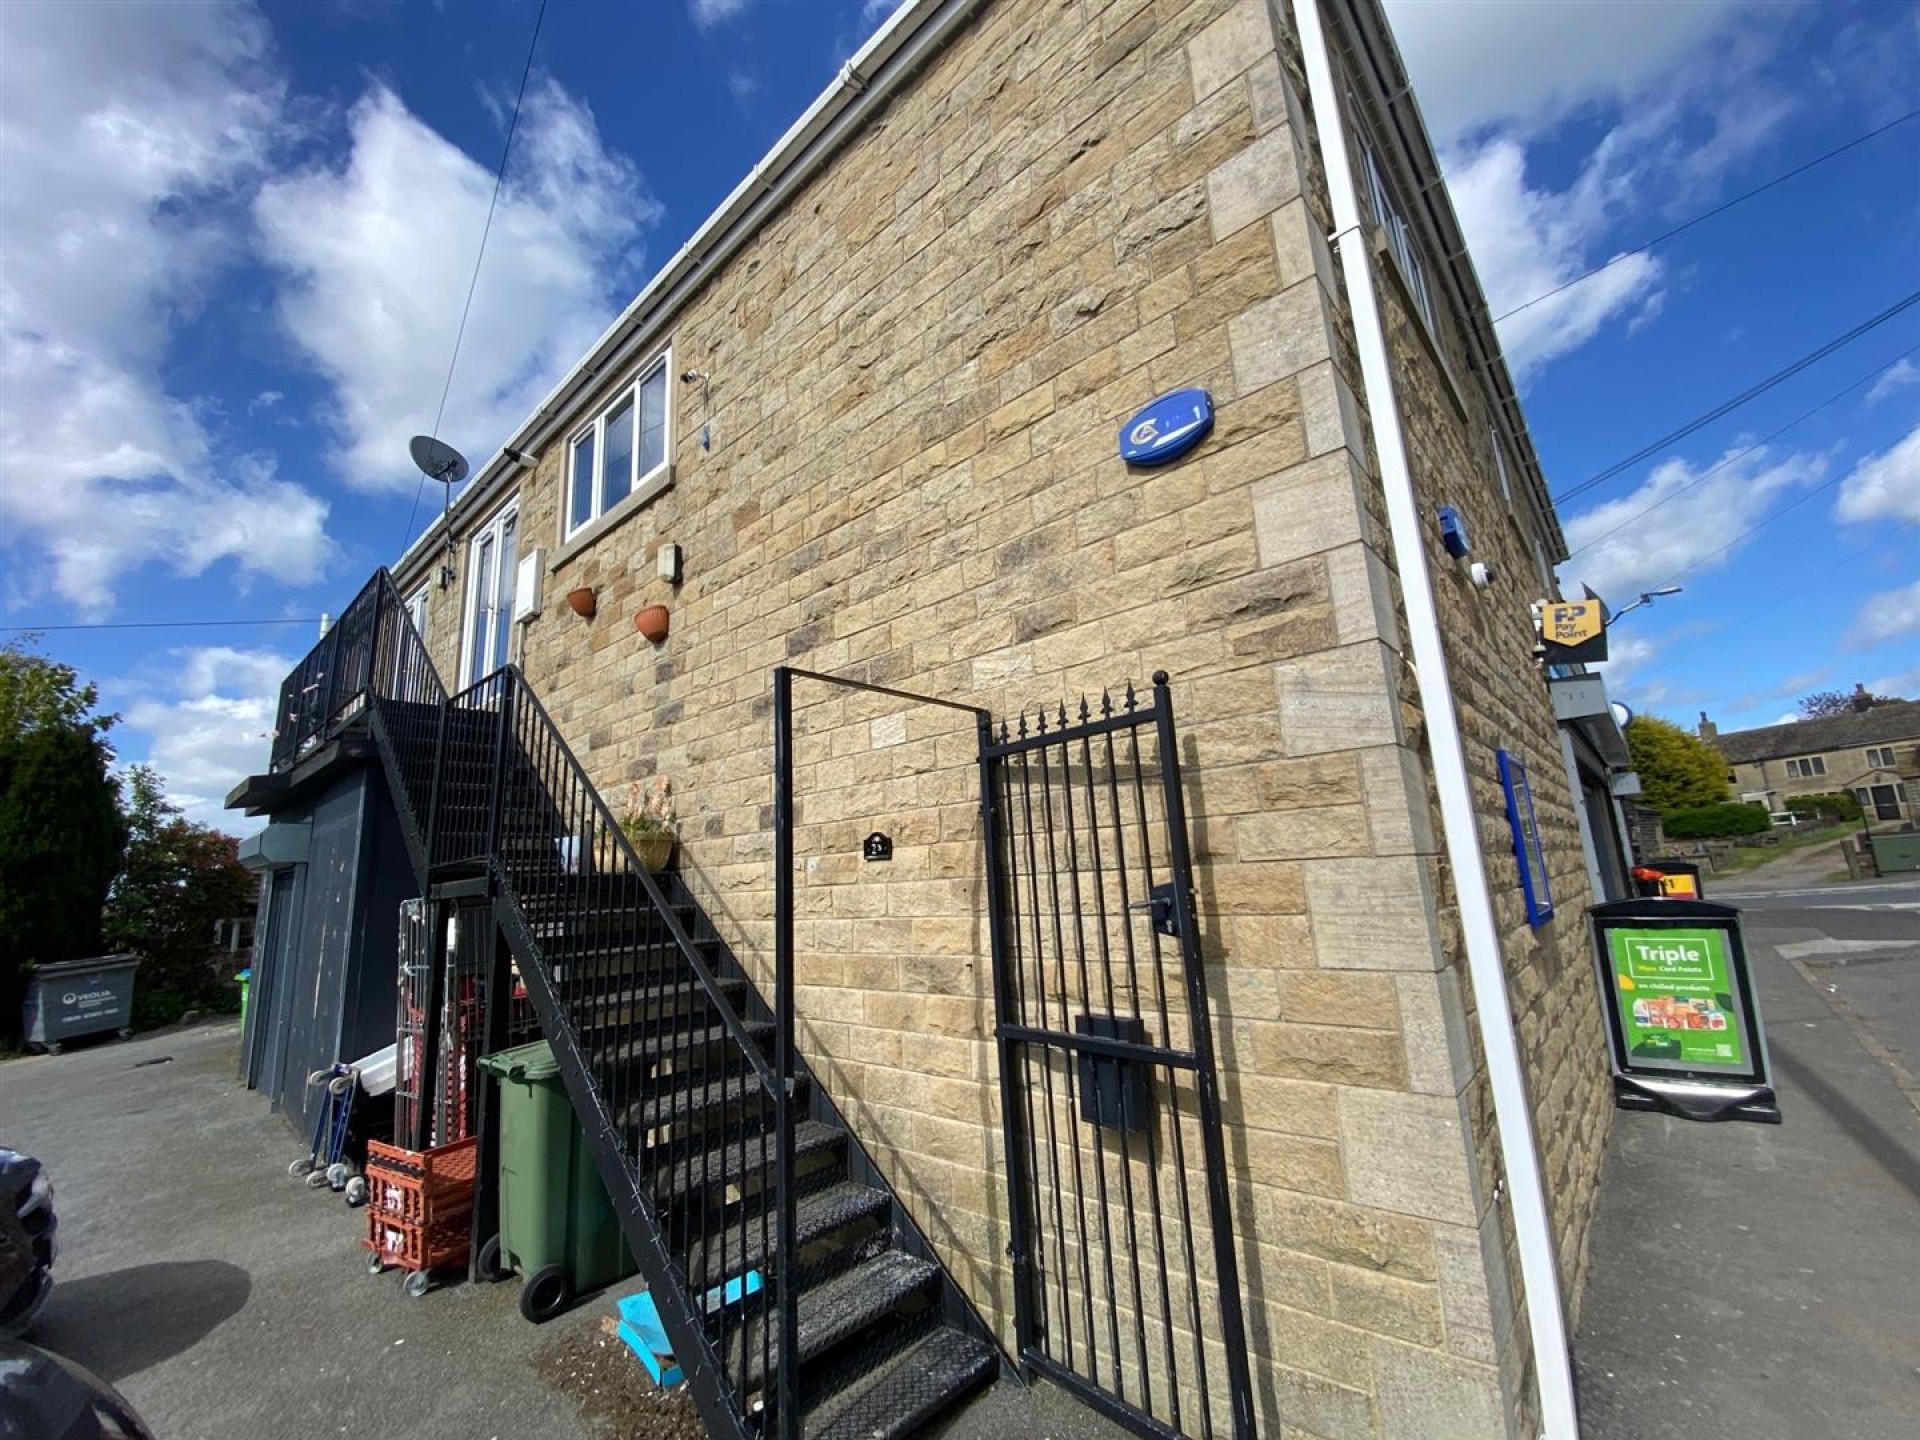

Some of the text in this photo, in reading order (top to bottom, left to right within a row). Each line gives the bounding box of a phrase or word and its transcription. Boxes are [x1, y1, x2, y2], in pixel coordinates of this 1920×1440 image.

[1555, 623, 1576, 631] Pay
[1555, 629, 1588, 639] Point
[1635, 944, 1700, 966] Triple
